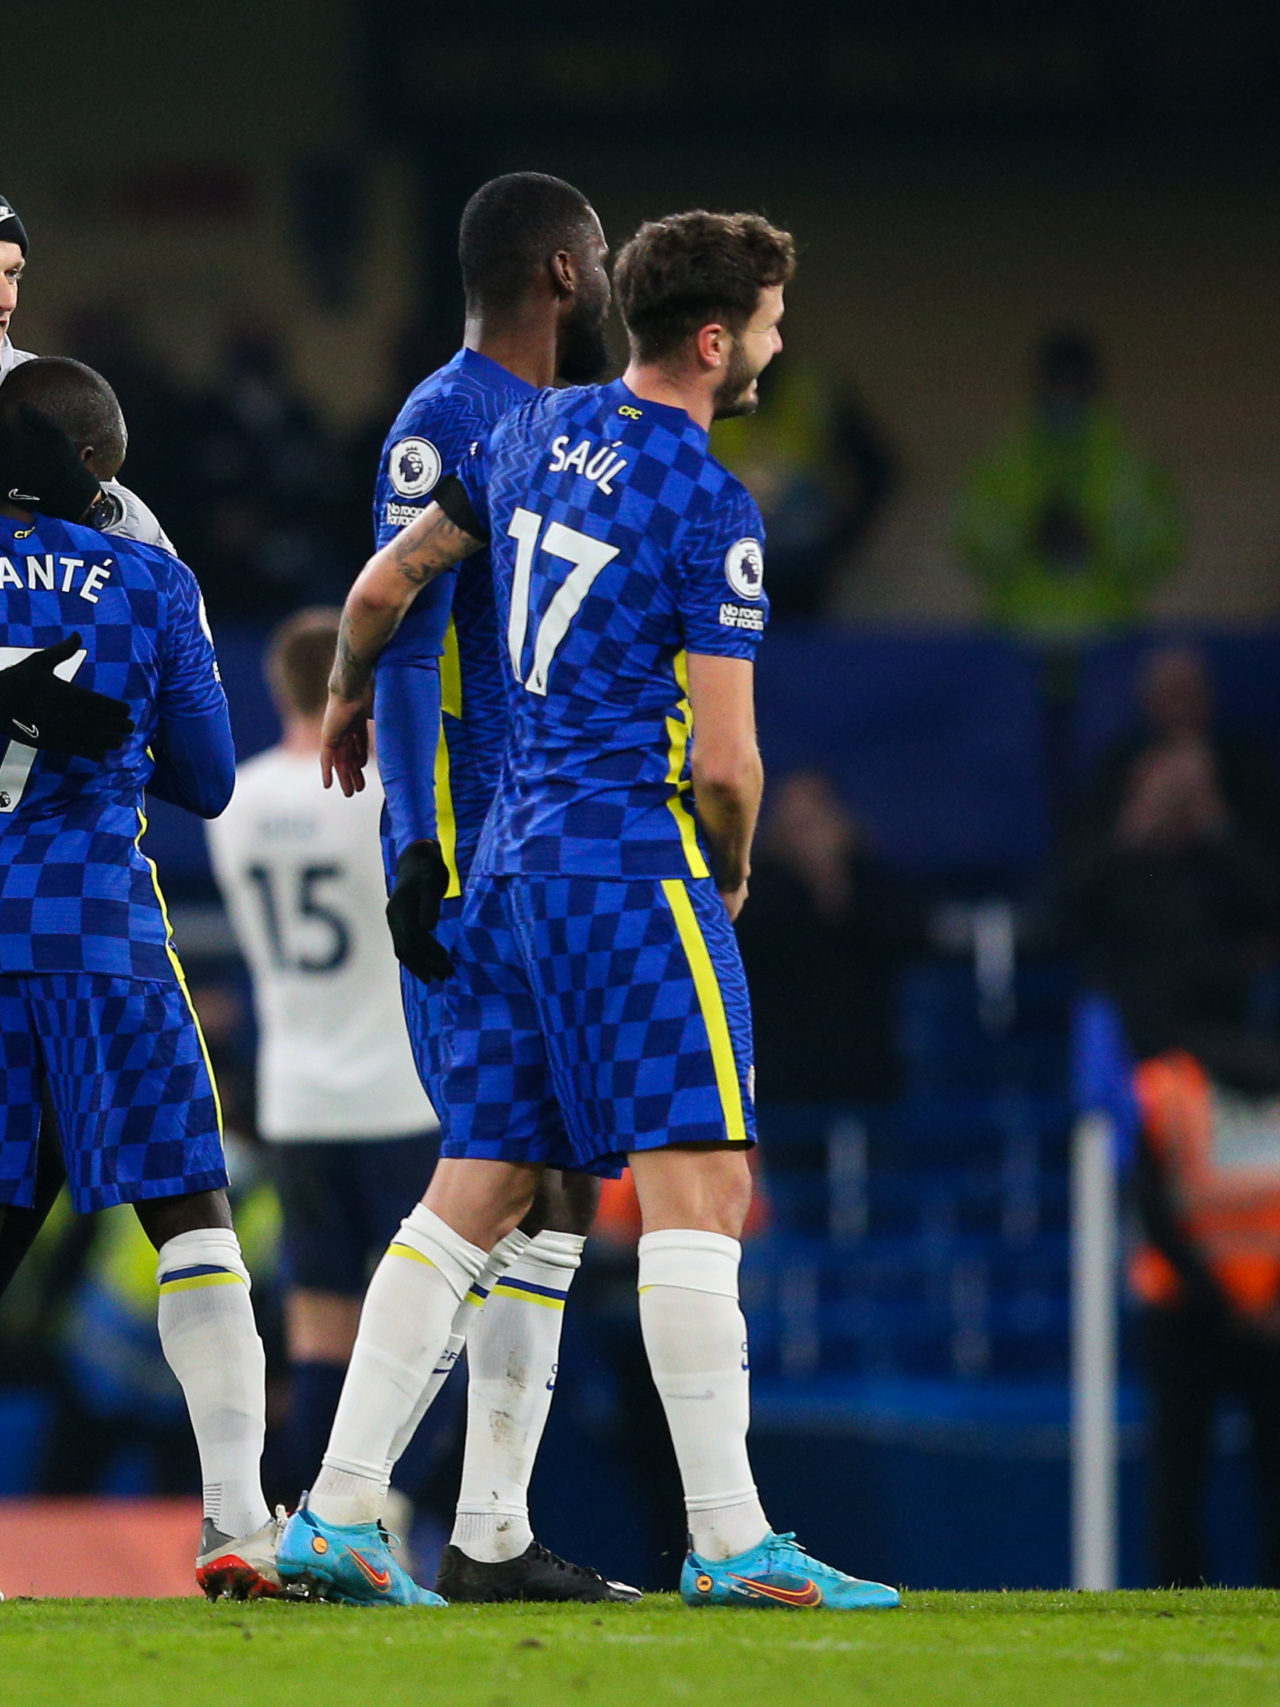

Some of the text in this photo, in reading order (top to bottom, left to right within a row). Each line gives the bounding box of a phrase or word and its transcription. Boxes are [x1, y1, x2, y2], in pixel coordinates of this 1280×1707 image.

[548, 434, 628, 496] SAÚL
[507, 506, 621, 697] 17
[719, 603, 739, 617] No
[244, 860, 354, 974] 15
